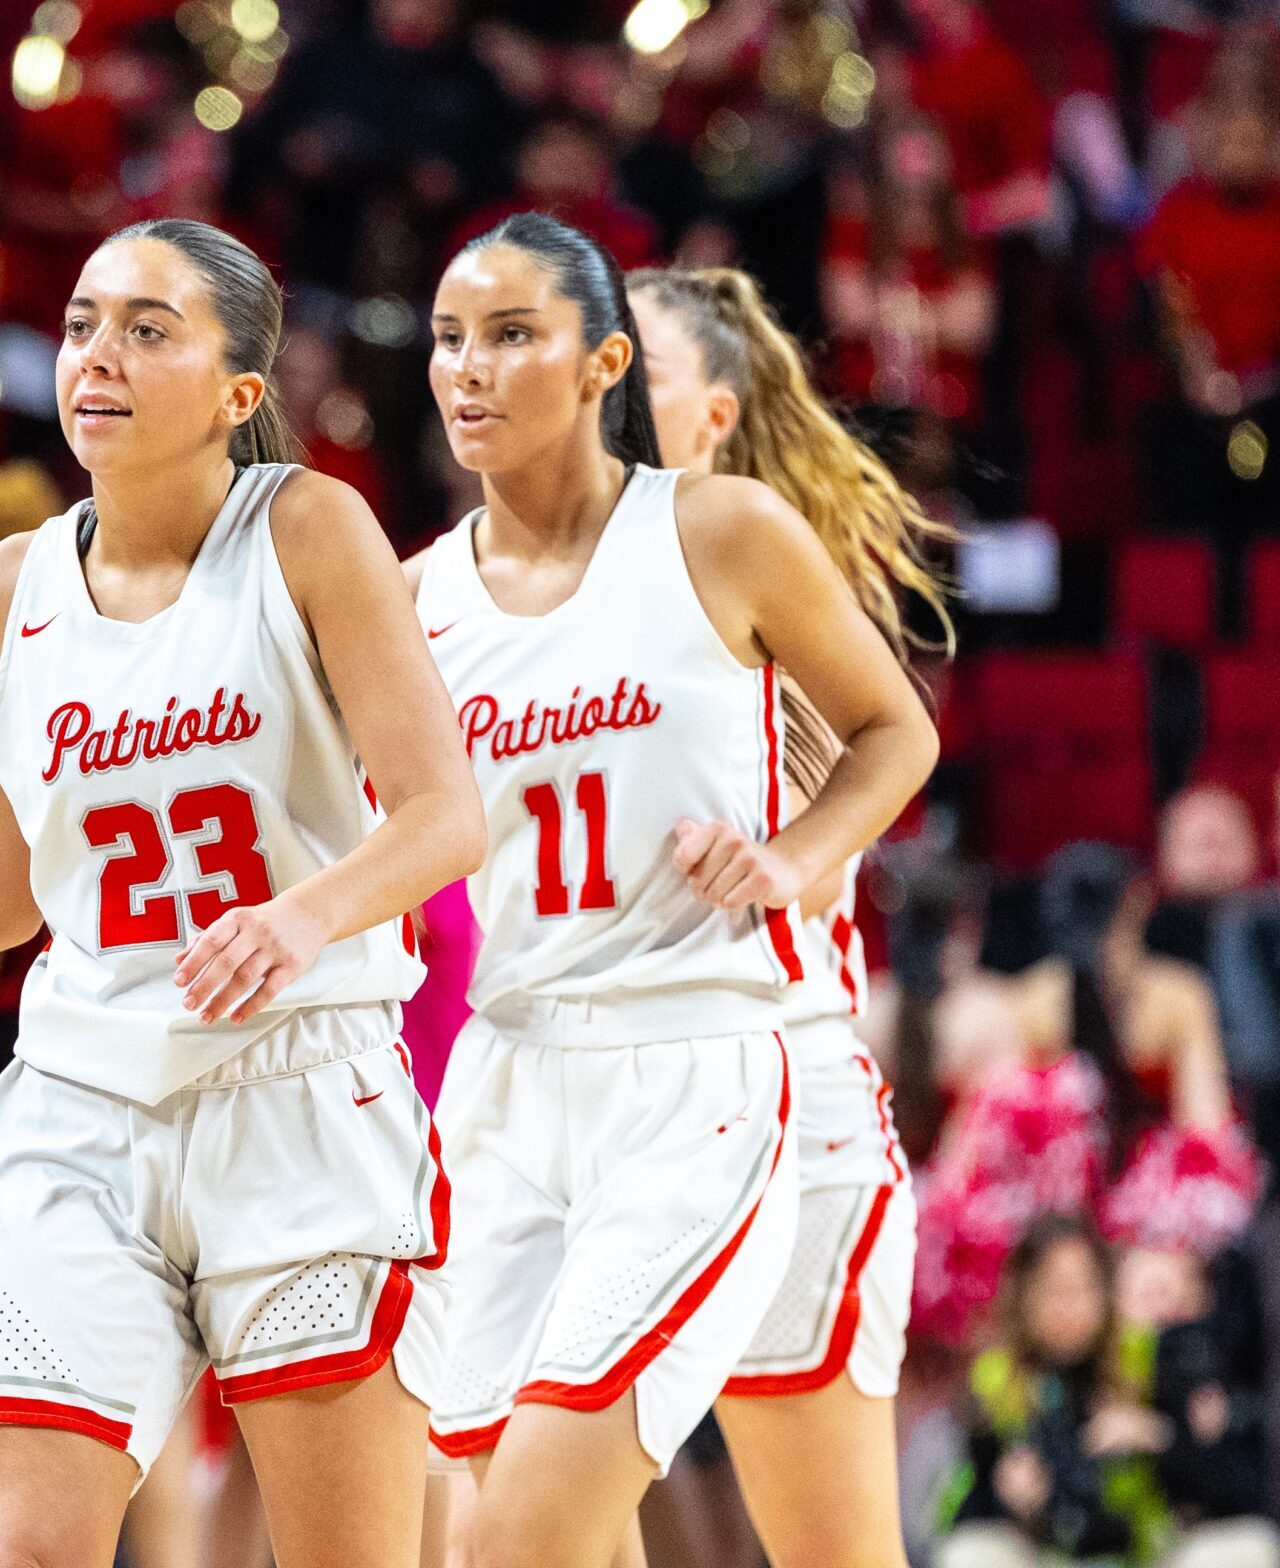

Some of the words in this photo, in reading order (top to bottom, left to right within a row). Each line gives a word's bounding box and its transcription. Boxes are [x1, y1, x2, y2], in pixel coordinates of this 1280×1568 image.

[40, 686, 263, 784] Patriots
[457, 676, 662, 762] Patriots
[79, 780, 276, 955] 23
[521, 769, 618, 918] 11
